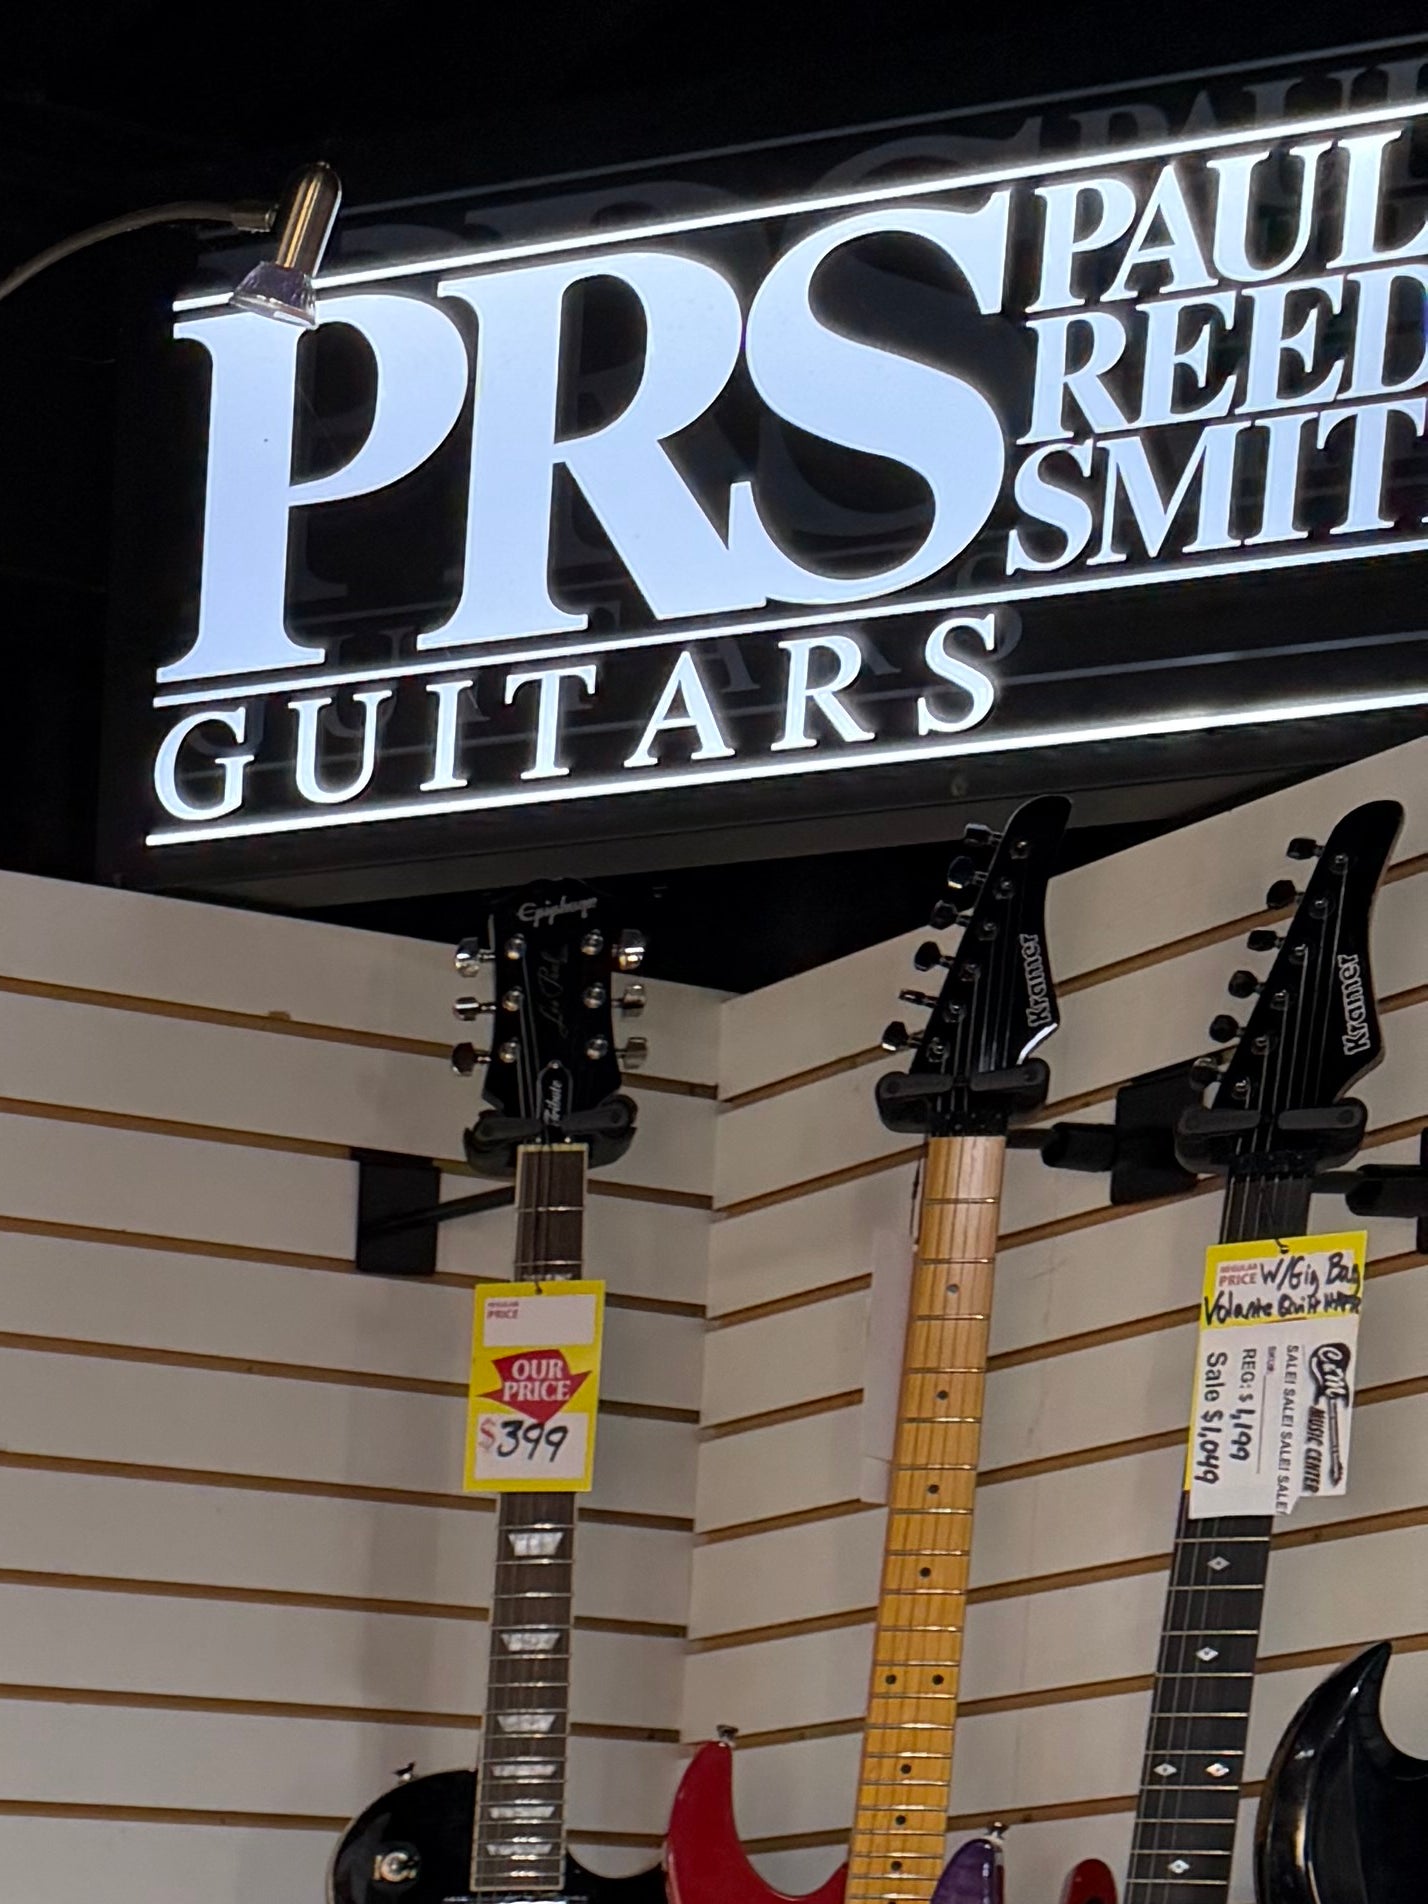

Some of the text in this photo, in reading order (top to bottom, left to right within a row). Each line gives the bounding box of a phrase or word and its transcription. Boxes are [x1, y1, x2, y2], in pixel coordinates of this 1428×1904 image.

[1024, 131, 1428, 314] PAUL
[1016, 264, 1428, 446] REED
[156, 190, 1012, 684] PRS
[1005, 397, 1428, 577] SMIT
[152, 612, 998, 822] GUITARS
[1018, 932, 1052, 1028] Kramer
[1337, 953, 1371, 1056] Kramer
[1218, 1272, 1257, 1287] PRICE
[502, 1380, 571, 1402] PRICE
[511, 1358, 563, 1380] OUR
[1203, 1352, 1228, 1402] Sale
[1239, 1348, 1257, 1390] REG:
[479, 1418, 568, 1463] $399
[1301, 1405, 1327, 1494] MUSIC CENTER
